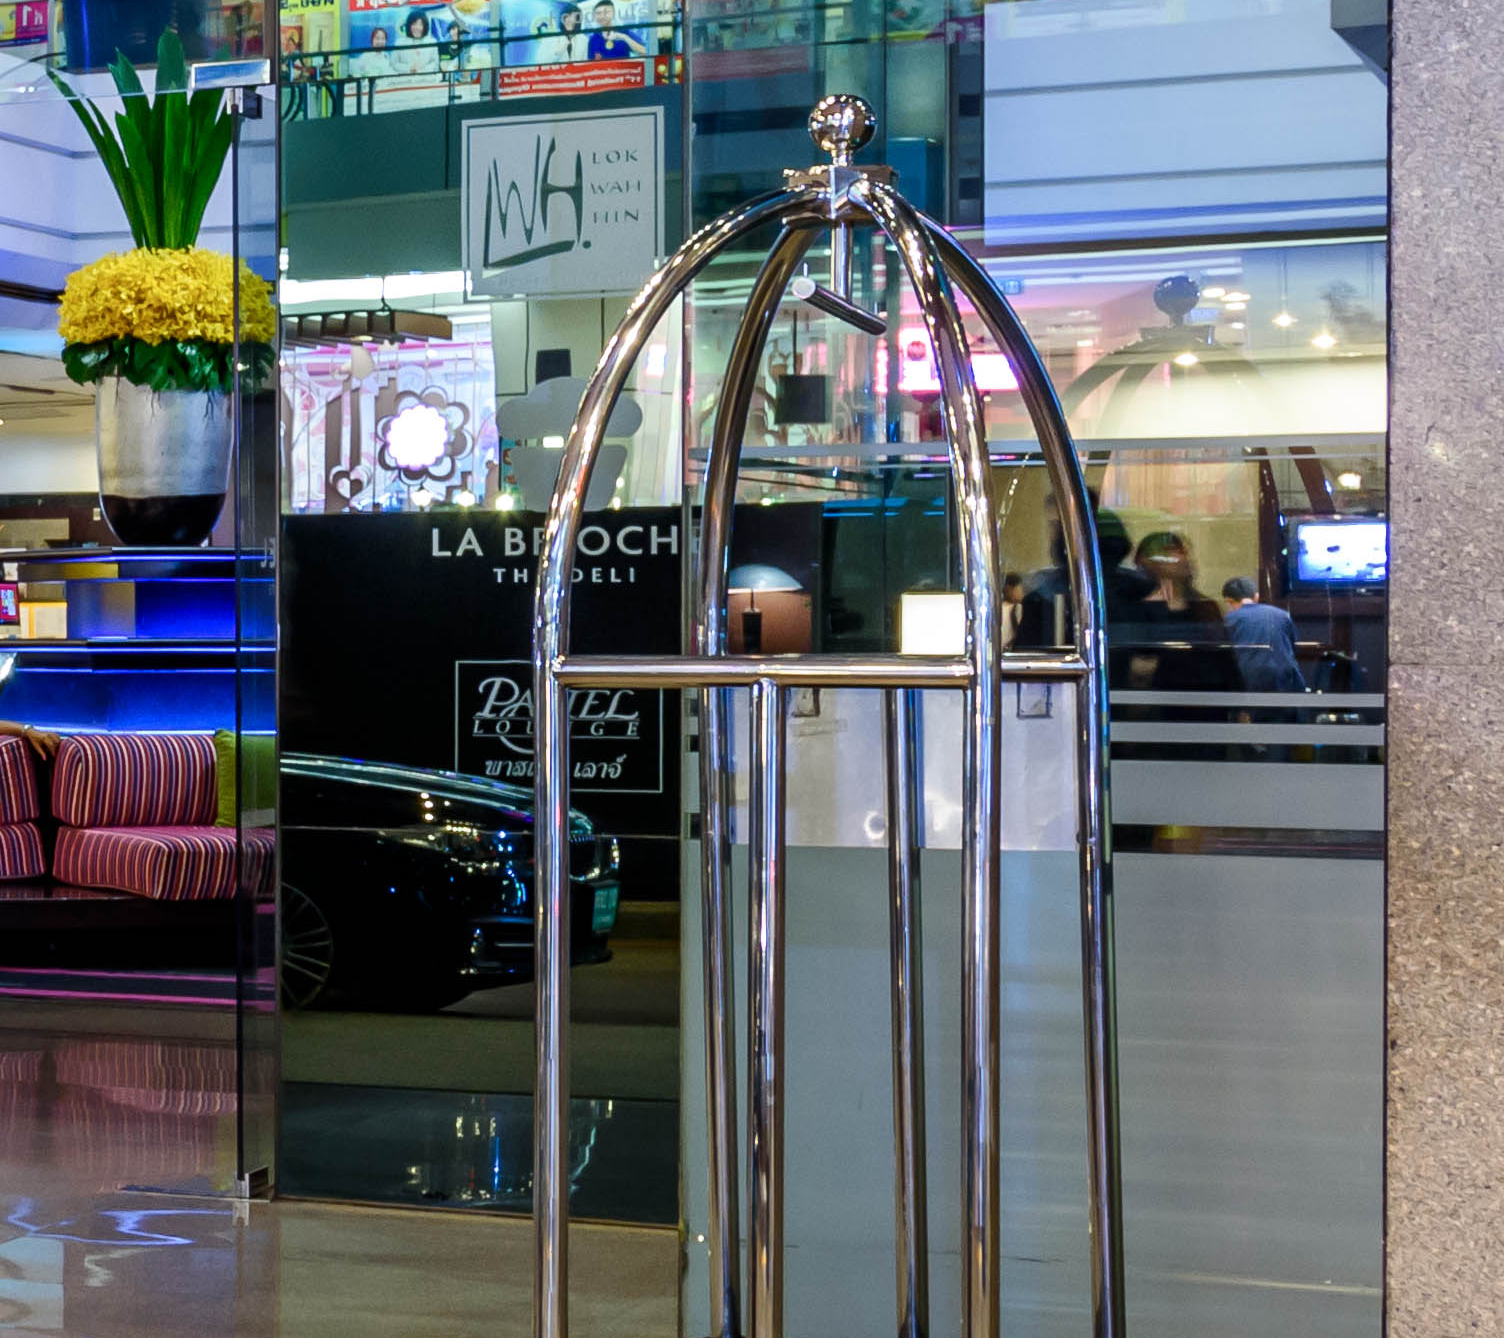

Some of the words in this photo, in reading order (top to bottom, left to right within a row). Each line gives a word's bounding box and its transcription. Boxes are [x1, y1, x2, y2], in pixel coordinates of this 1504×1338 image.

[592, 148, 639, 165] LOK
[590, 180, 641, 195] WAH
[593, 209, 640, 224] HIN
[431, 527, 484, 557] LA
[504, 525, 693, 557] BOCH
[493, 567, 530, 584] TH
[570, 567, 636, 584] DELI
[474, 676, 640, 720] PATEL
[472, 719, 640, 737] LOGE
